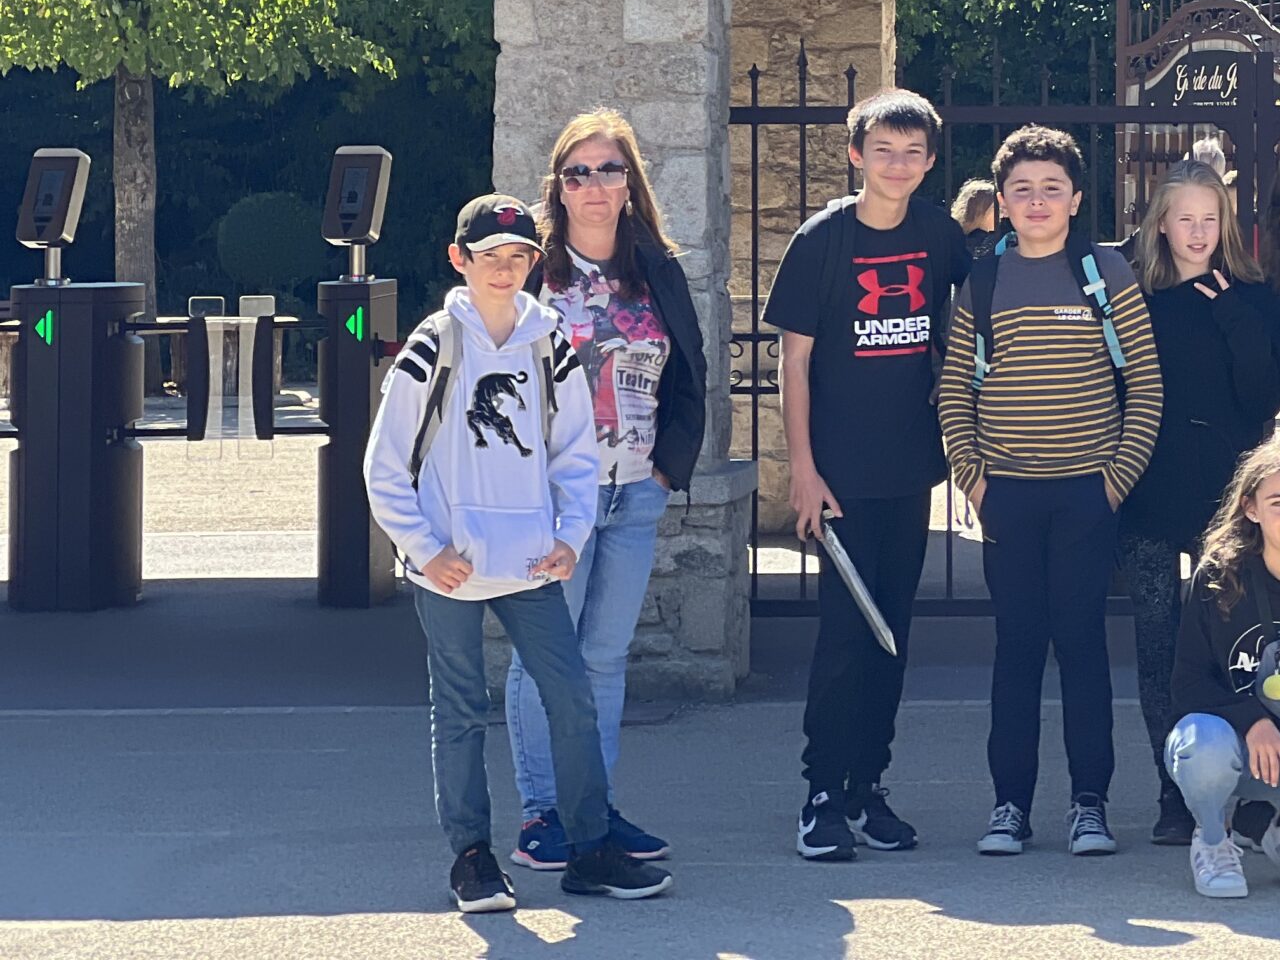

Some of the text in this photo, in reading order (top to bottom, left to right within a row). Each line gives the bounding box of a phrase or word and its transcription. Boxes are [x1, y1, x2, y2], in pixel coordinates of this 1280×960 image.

[854, 315, 930, 335] UNDER
[856, 330, 930, 346] ARMOUR
[617, 369, 657, 392] Teatr
